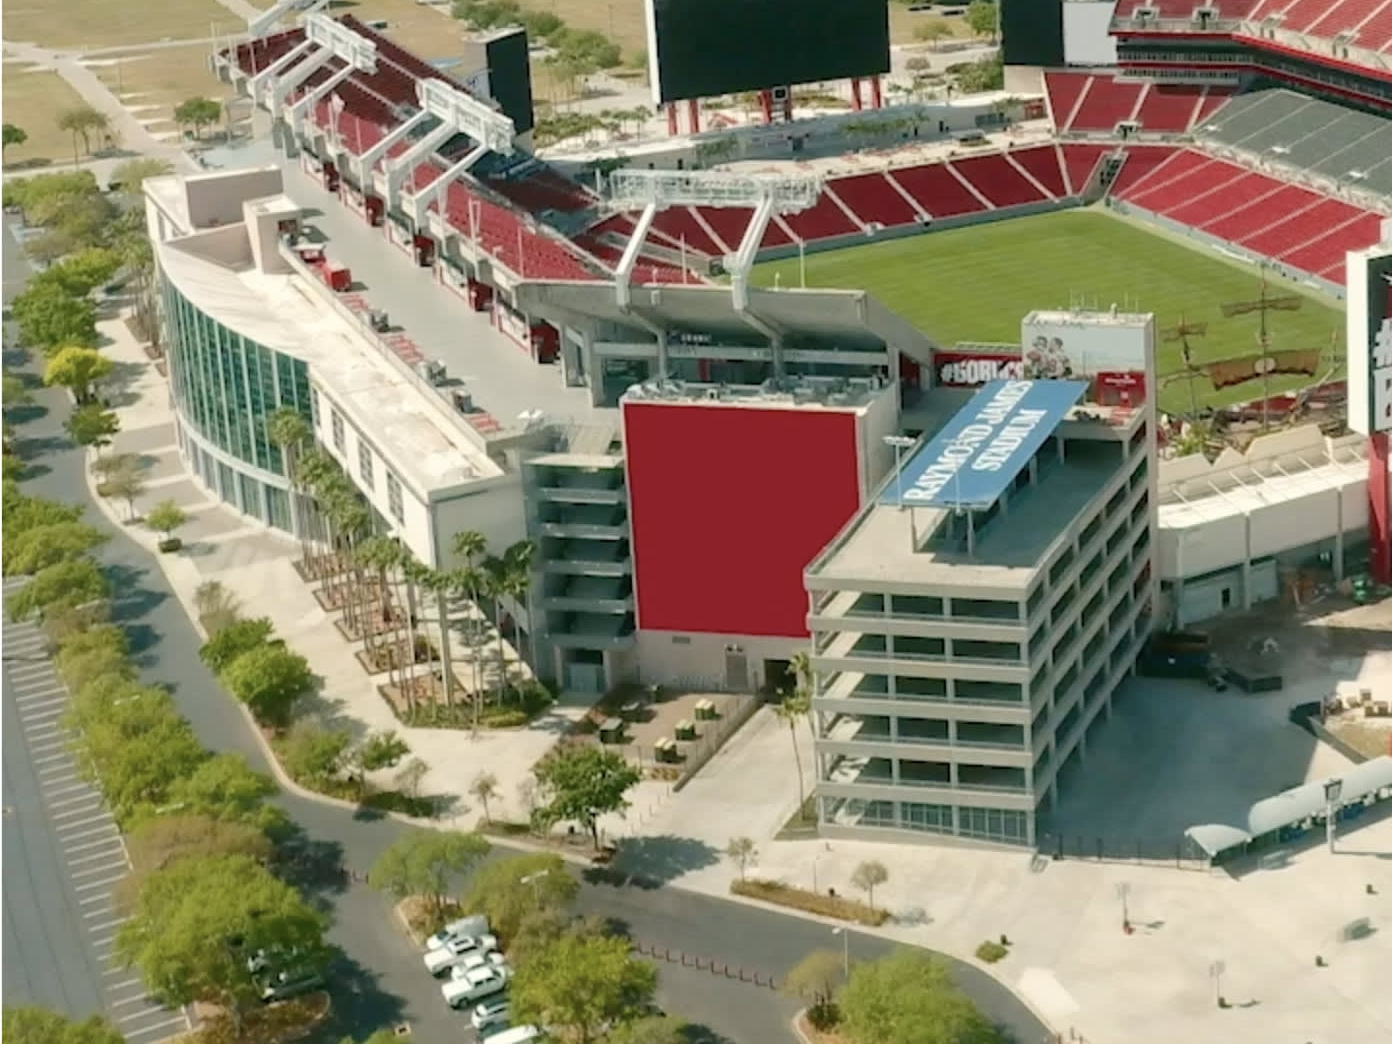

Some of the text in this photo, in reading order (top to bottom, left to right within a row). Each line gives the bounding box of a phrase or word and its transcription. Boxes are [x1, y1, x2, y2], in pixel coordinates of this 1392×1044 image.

[903, 380, 1033, 500] RAYMOND JAMES
[971, 409, 1048, 471] STADIUM
